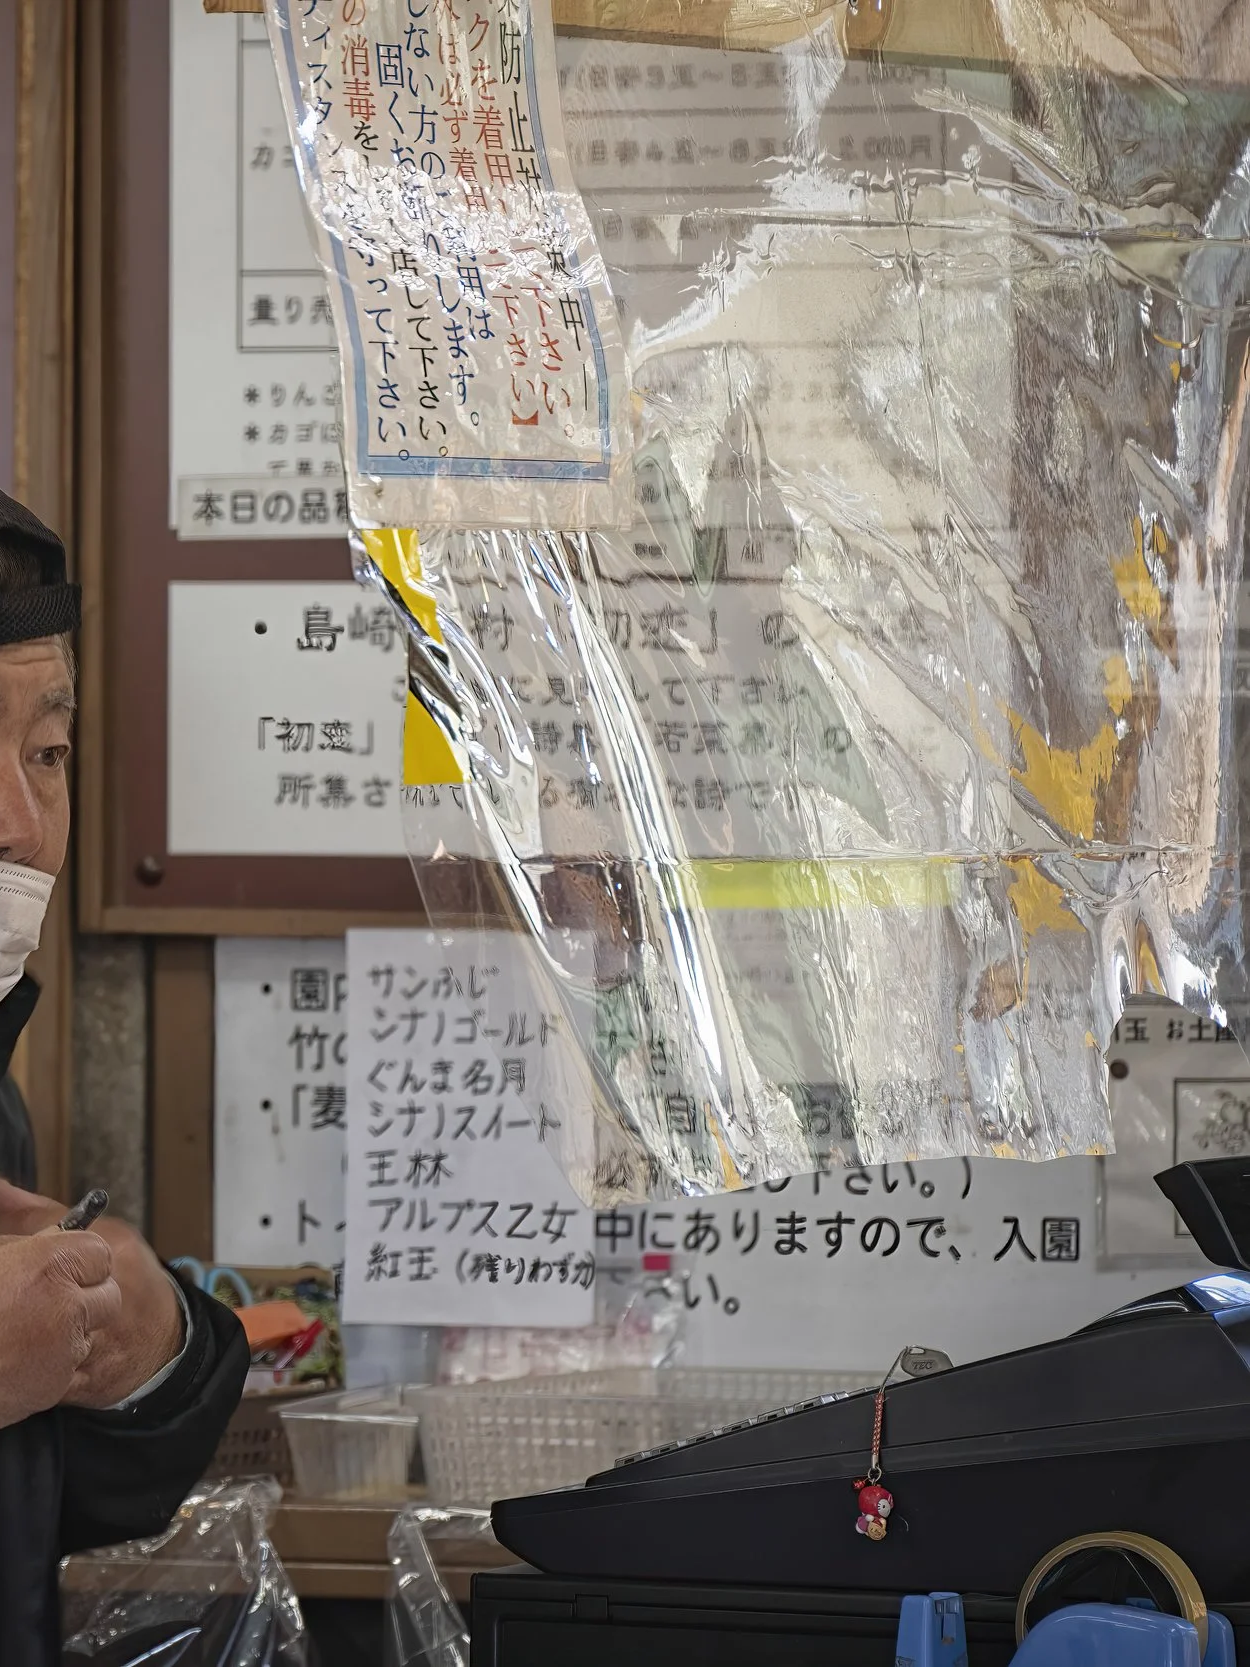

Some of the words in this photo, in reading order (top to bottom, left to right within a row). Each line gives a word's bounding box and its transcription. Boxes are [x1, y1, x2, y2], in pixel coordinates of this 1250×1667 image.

[366, 1148, 455, 1189] 王林
[296, 1198, 347, 1245] ト
[367, 1197, 581, 1244] アルプス乙女
